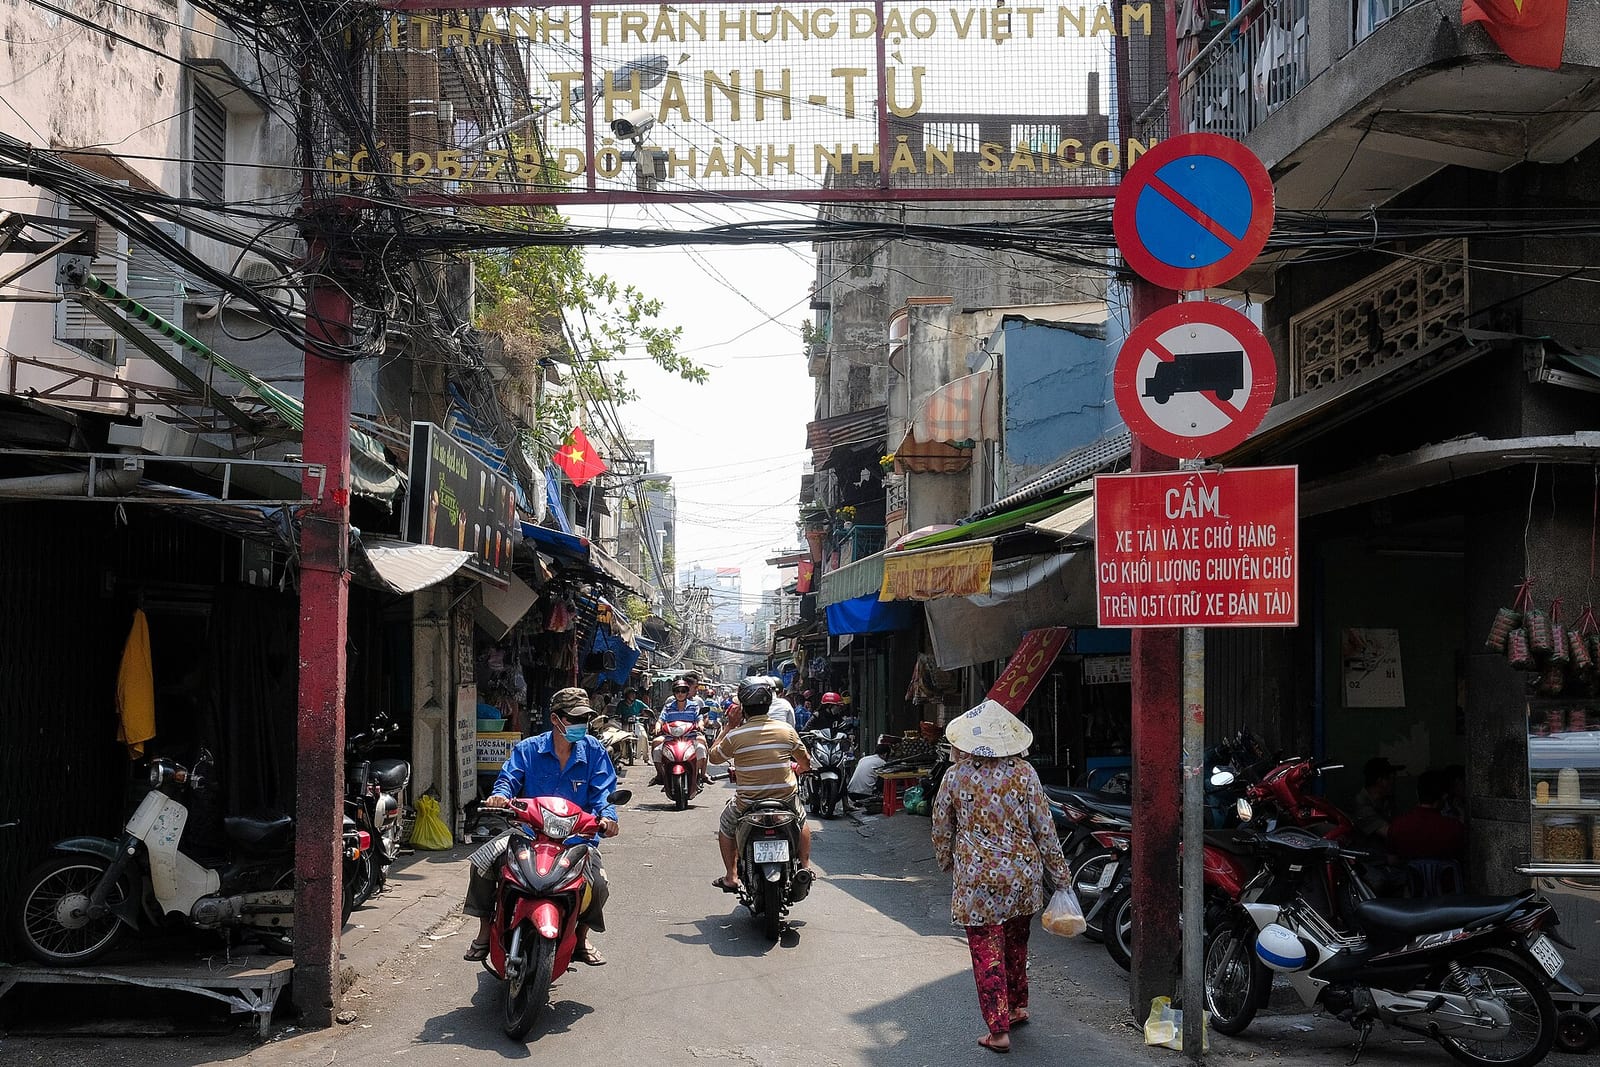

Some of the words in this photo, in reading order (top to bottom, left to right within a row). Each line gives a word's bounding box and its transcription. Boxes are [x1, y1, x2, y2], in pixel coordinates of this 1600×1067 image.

[719, 6, 838, 42] HƯNG
[1057, 3, 1152, 38] NAM
[978, 137, 1158, 174] SAIGON
[1164, 476, 1220, 520] CẤM
[1115, 530, 1132, 553] XE
[1137, 524, 1157, 552] TẢI
[1162, 524, 1178, 551] VÀ
[1182, 526, 1199, 550] XE
[1204, 521, 1232, 549] CHỞ
[1238, 521, 1276, 549] HÀNG
[1101, 558, 1117, 584] CÓ
[1121, 555, 1151, 584] KHỐI
[1156, 558, 1200, 586] LƯỢNG
[1206, 554, 1259, 581] CHUYÊN
[1263, 548, 1292, 579] CHỞ
[1103, 592, 1136, 618] TRÊN
[1205, 593, 1224, 616] XE
[1228, 589, 1259, 616] BÁN
